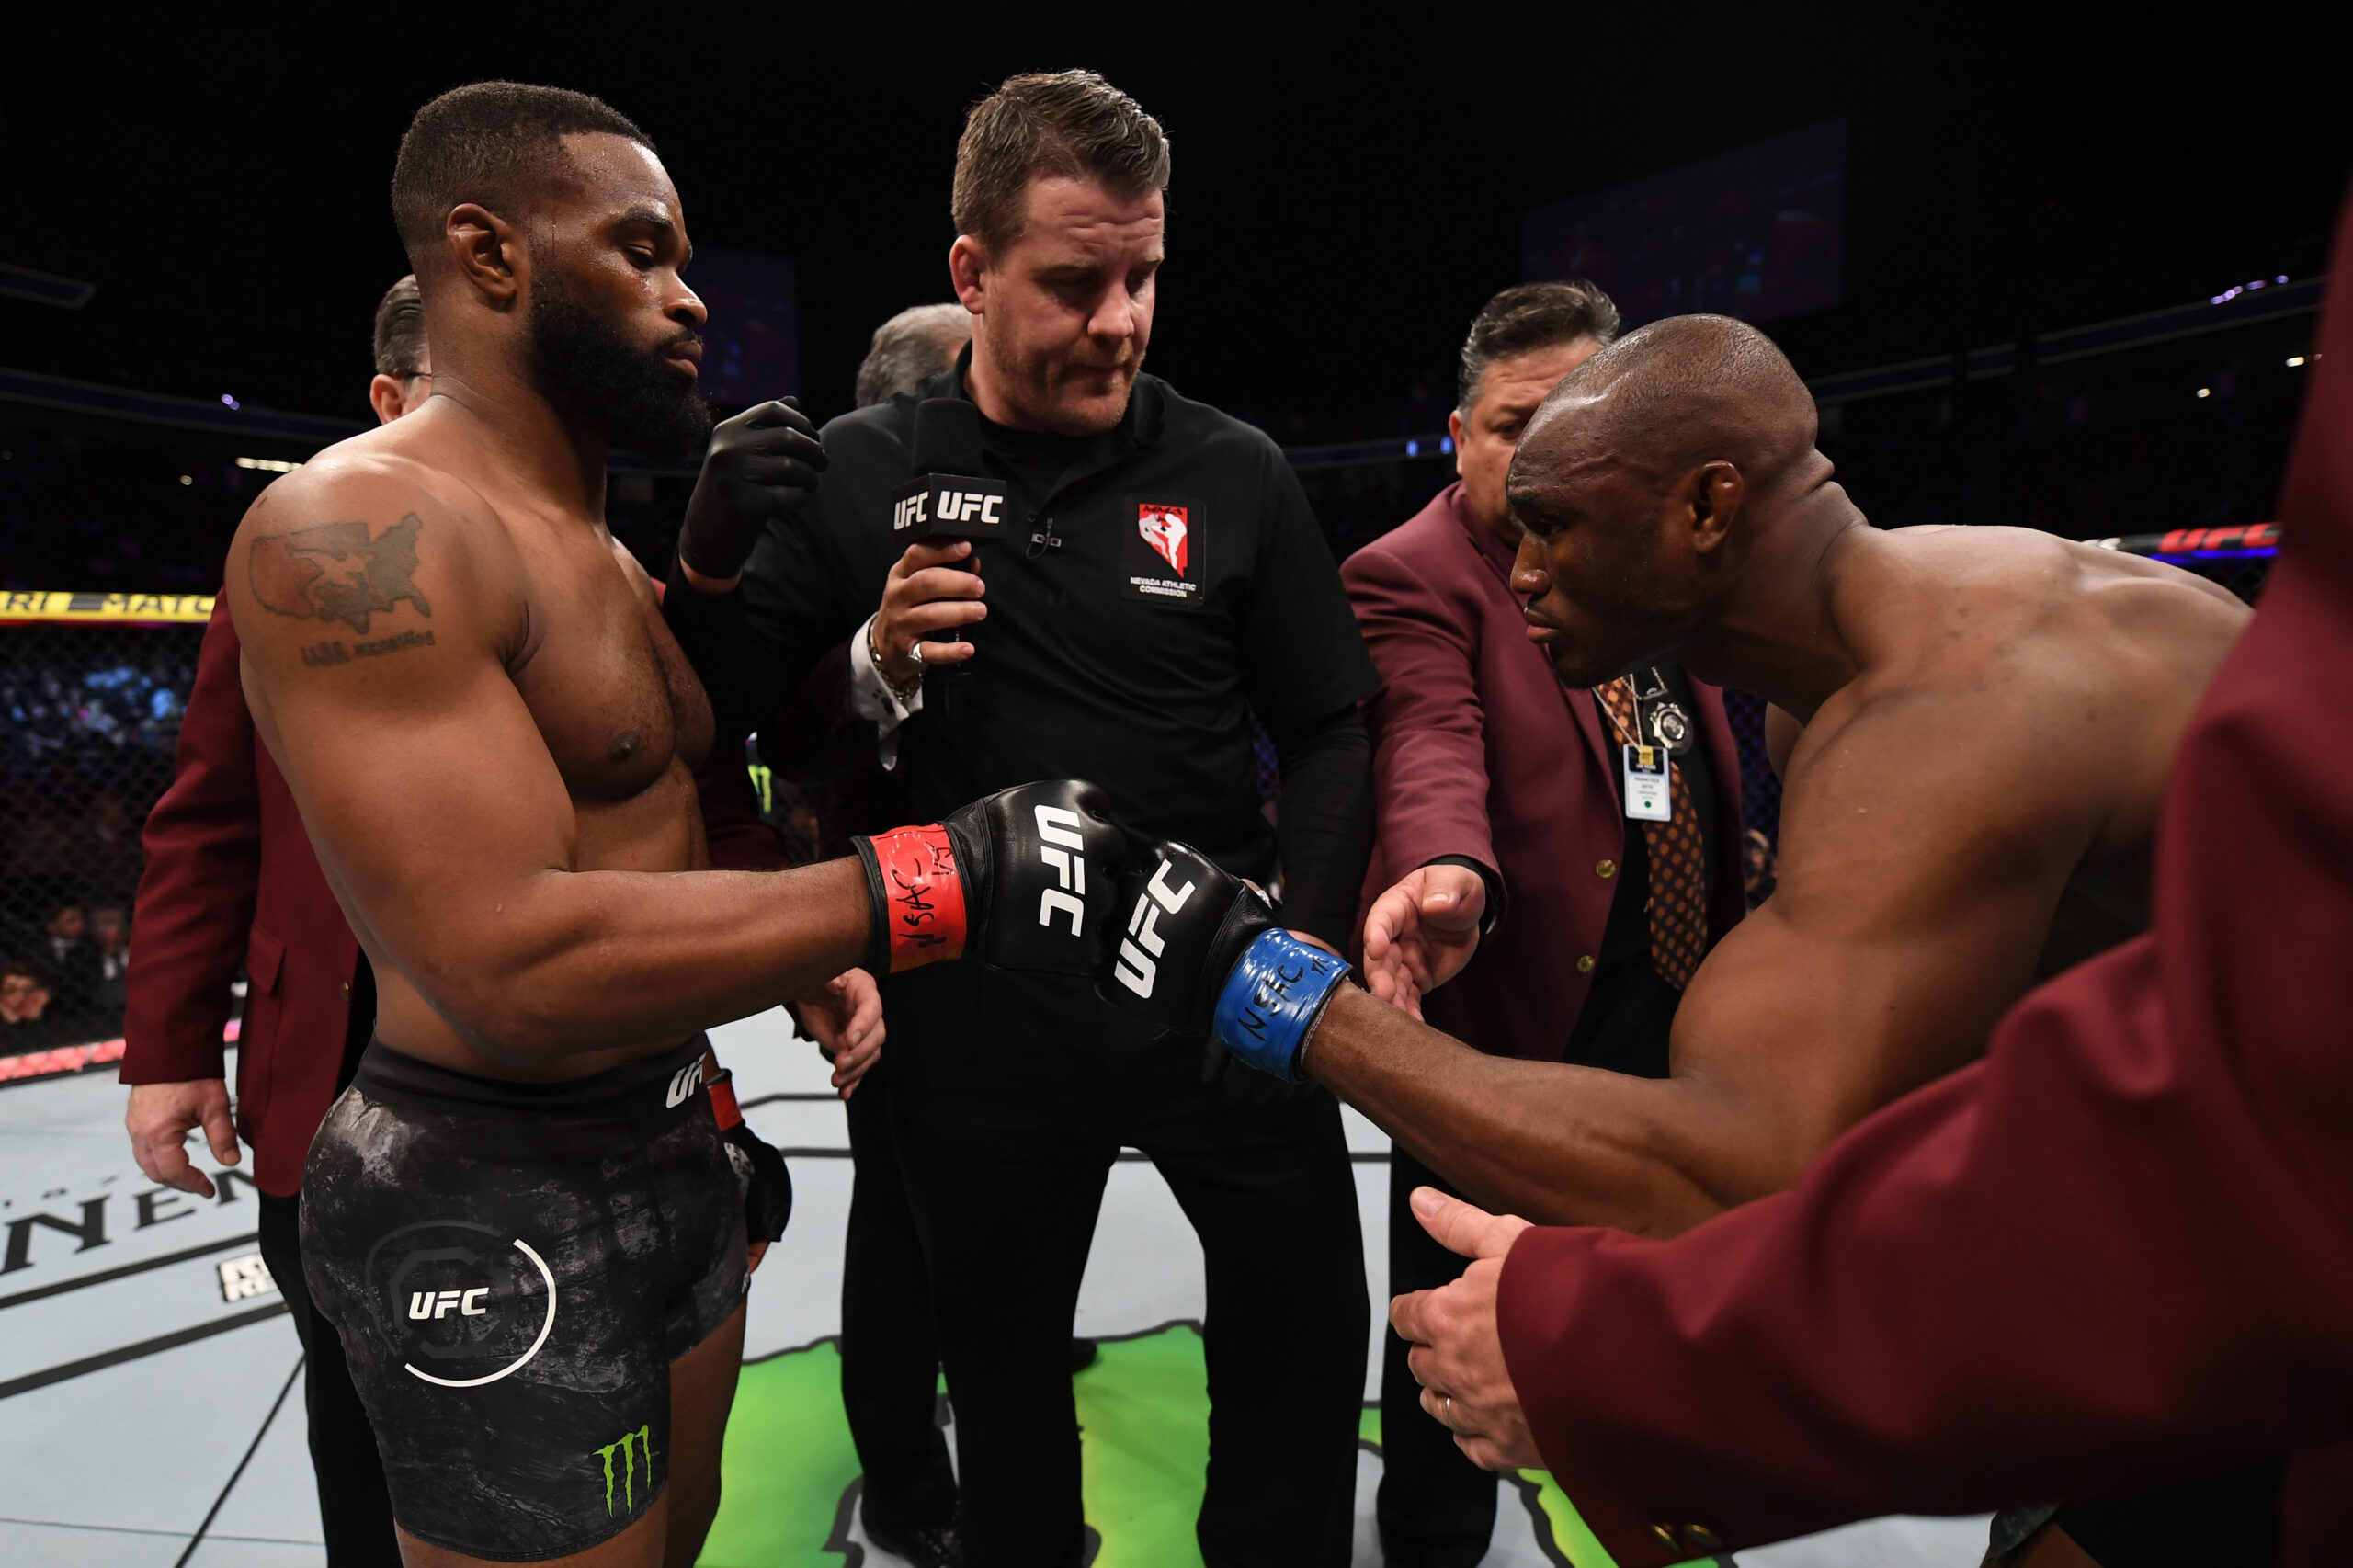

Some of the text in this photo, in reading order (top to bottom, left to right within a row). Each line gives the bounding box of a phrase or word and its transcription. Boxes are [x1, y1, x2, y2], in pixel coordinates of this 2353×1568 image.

[893, 491, 929, 530] UFC
[937, 490, 1004, 524] UFC
[1130, 576, 1196, 591] NEVADA ATHLETIC
[1140, 585, 1187, 597] COMMISSION
[1034, 804, 1086, 937] UFC
[1113, 858, 1196, 999] UFC
[409, 1287, 490, 1320] UFC
